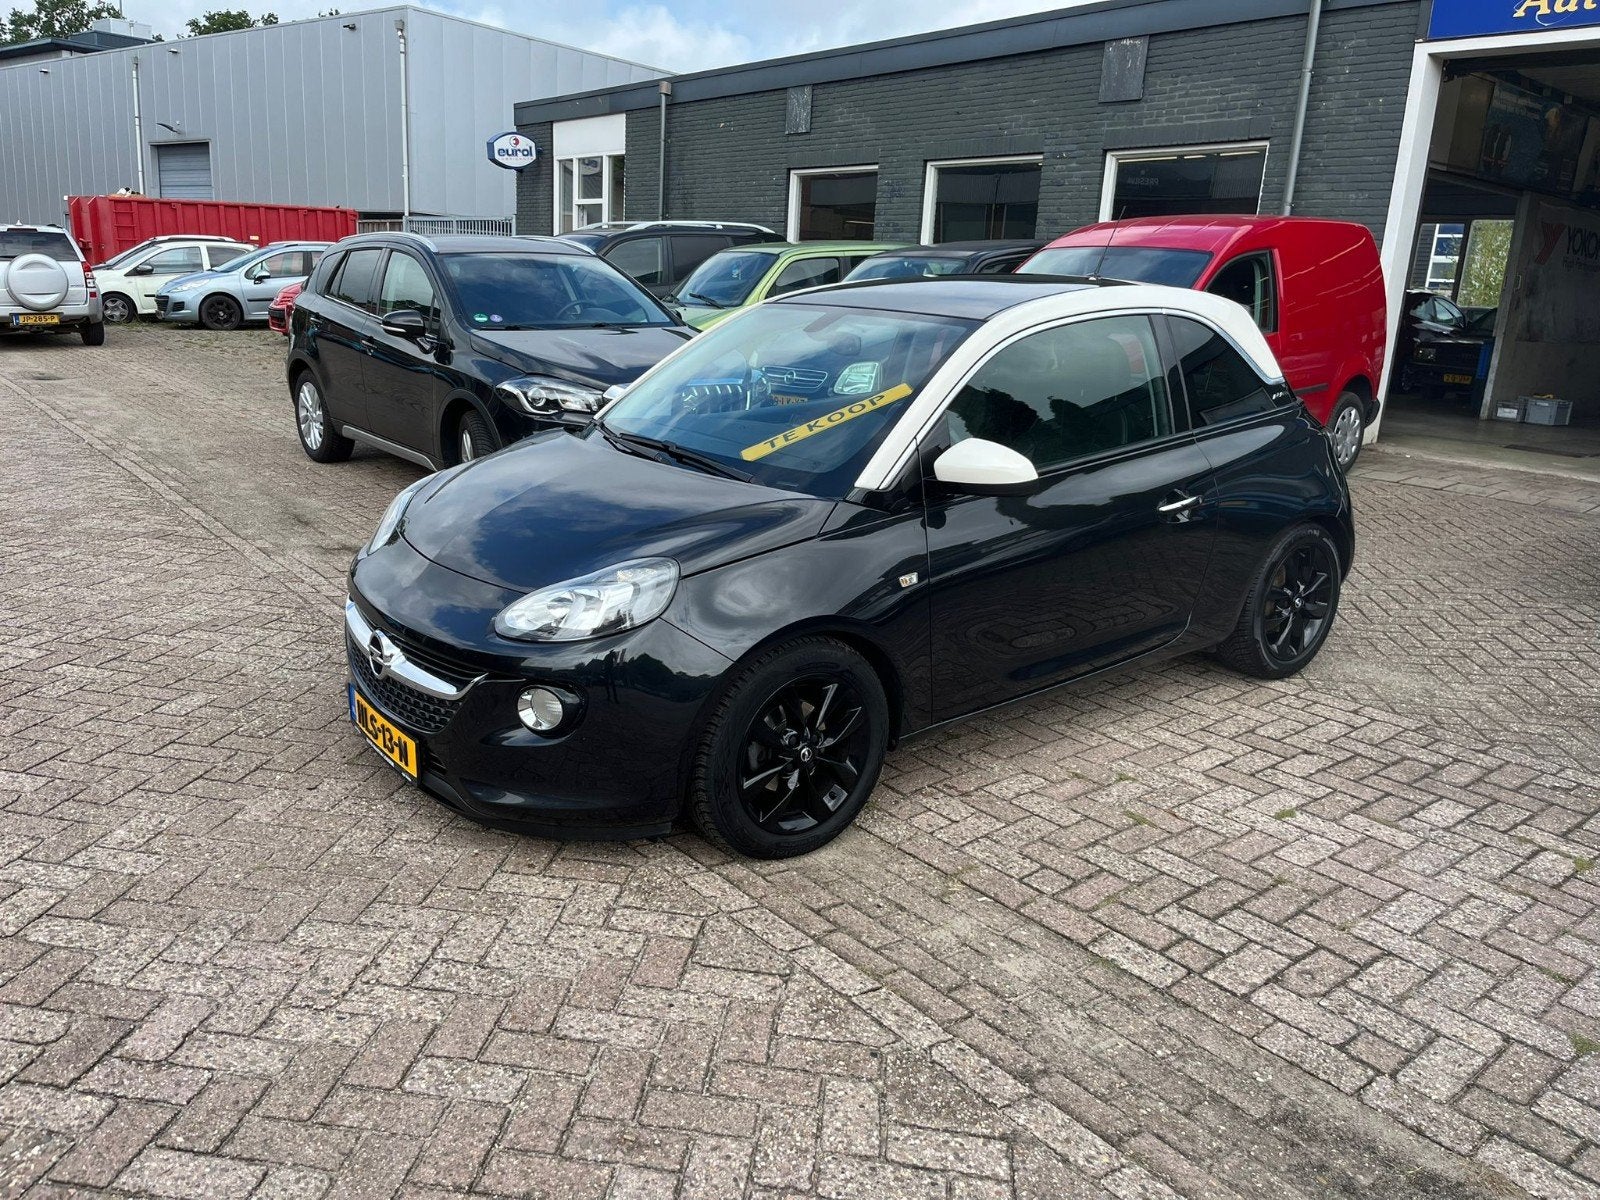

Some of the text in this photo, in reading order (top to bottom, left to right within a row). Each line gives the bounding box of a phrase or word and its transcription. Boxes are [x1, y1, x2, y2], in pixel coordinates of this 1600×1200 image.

[497, 145, 533, 157] eurol
[22, 315, 56, 323] JP-285-P
[763, 431, 799, 450] TE
[807, 393, 887, 432] KOOP
